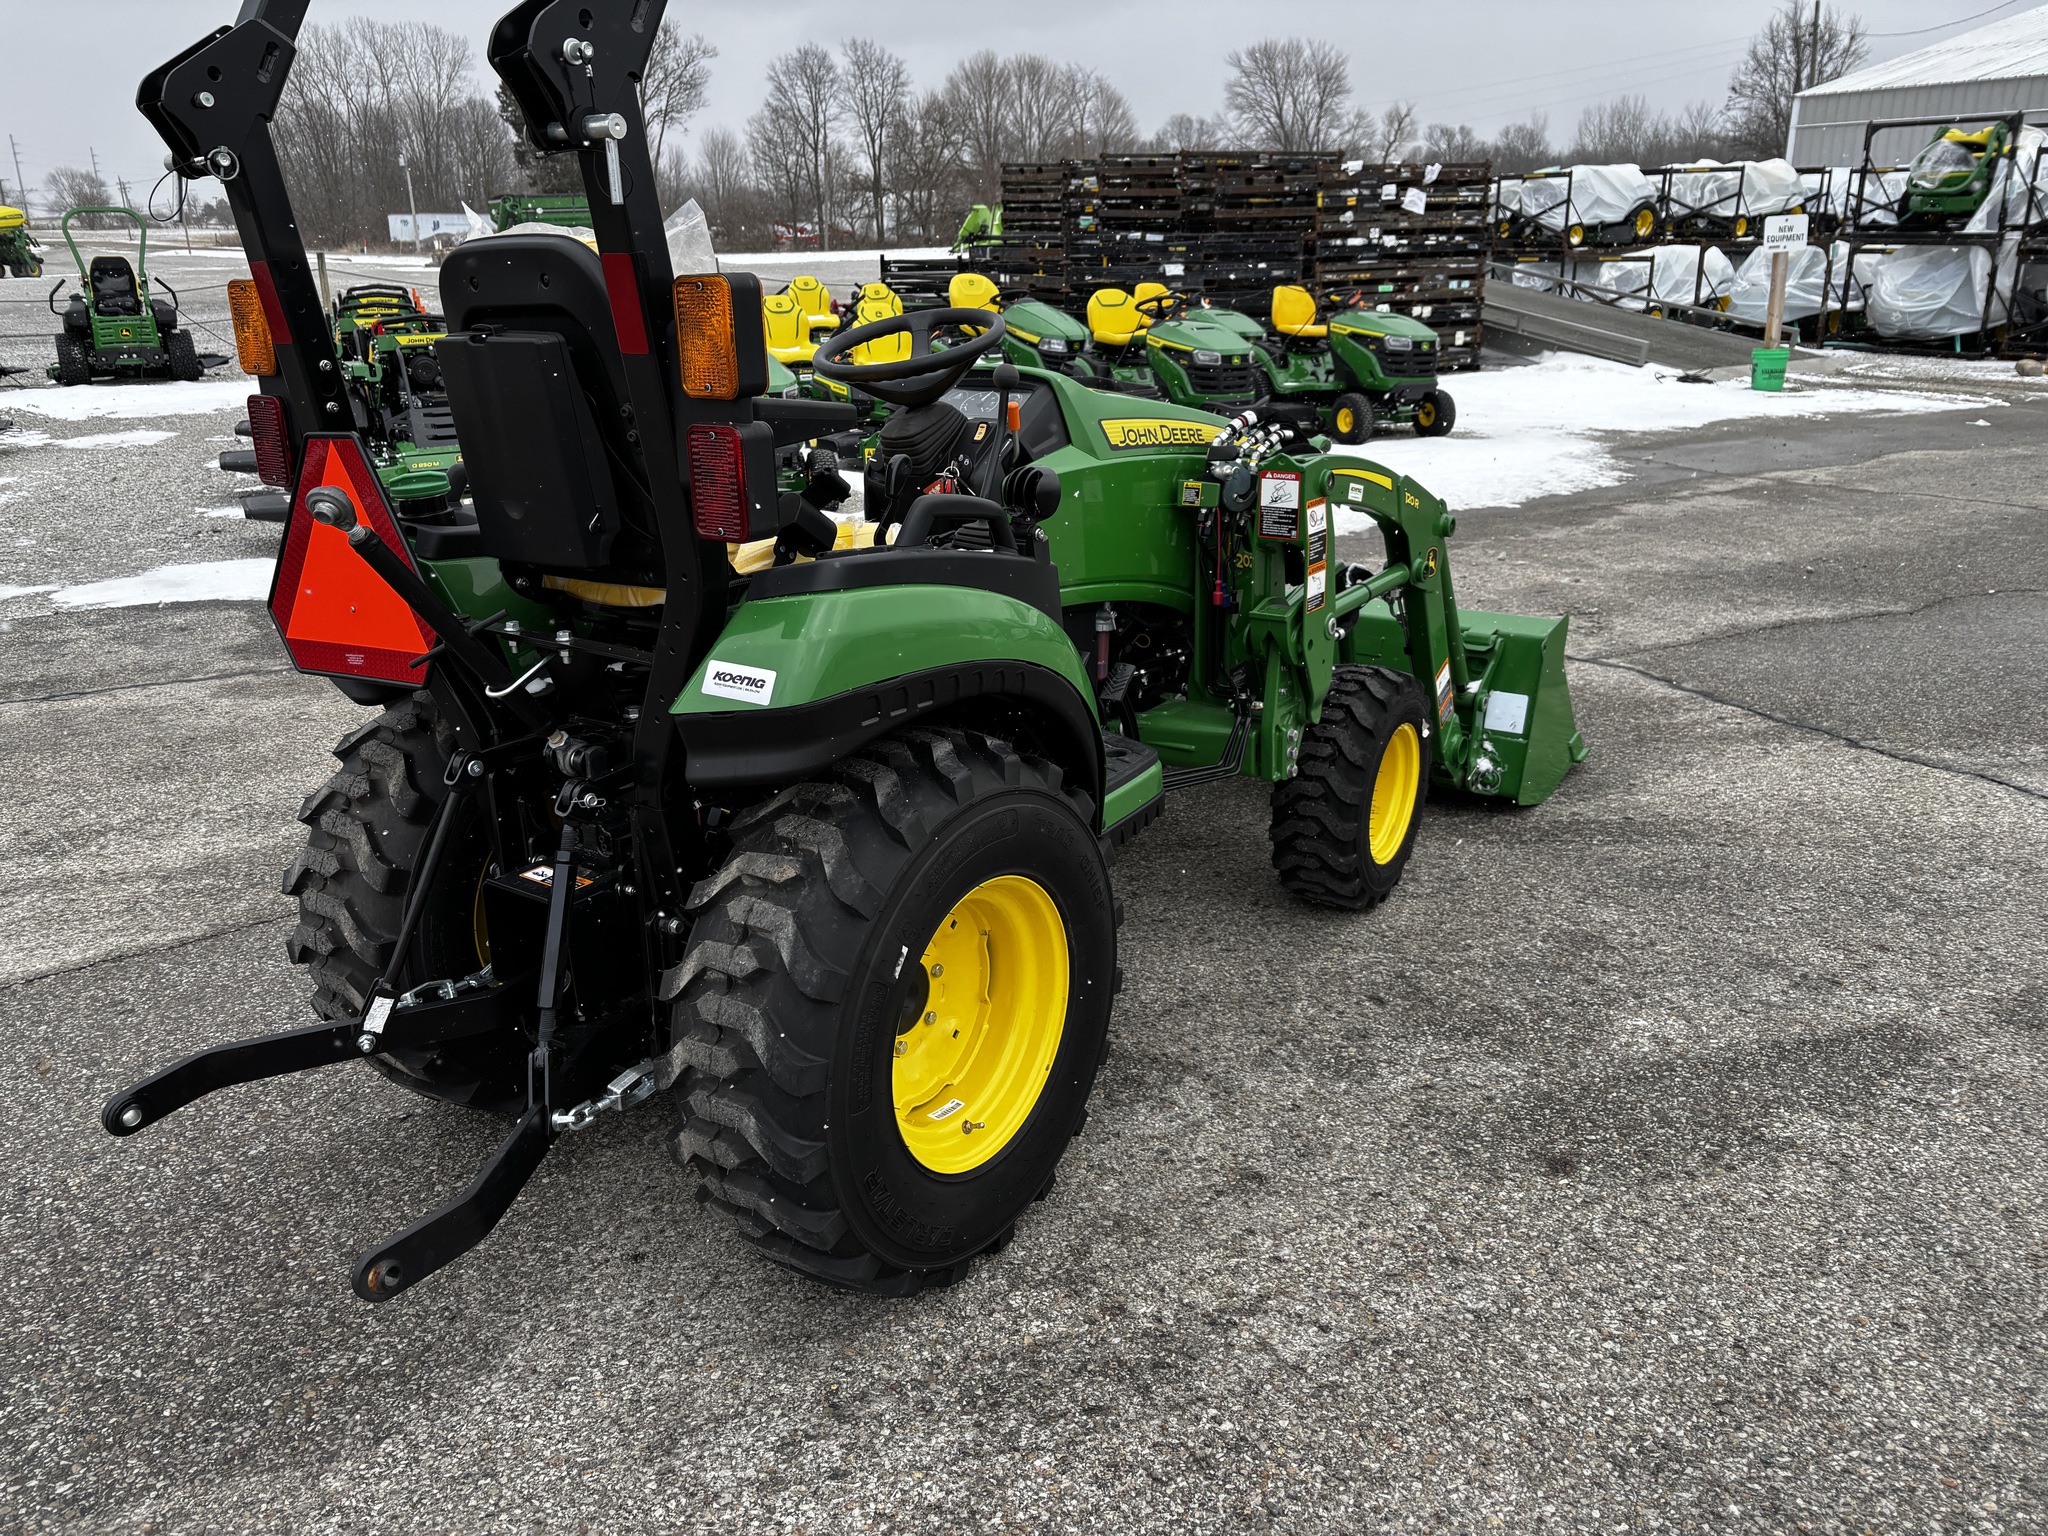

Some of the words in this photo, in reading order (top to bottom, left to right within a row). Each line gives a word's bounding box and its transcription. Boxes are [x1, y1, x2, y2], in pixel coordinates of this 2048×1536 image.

[1779, 225, 1794, 233] NEW
[1766, 233, 1805, 243] EQUIPMENT
[1119, 426, 1159, 445] JOHN
[1159, 424, 1205, 443] DEERE
